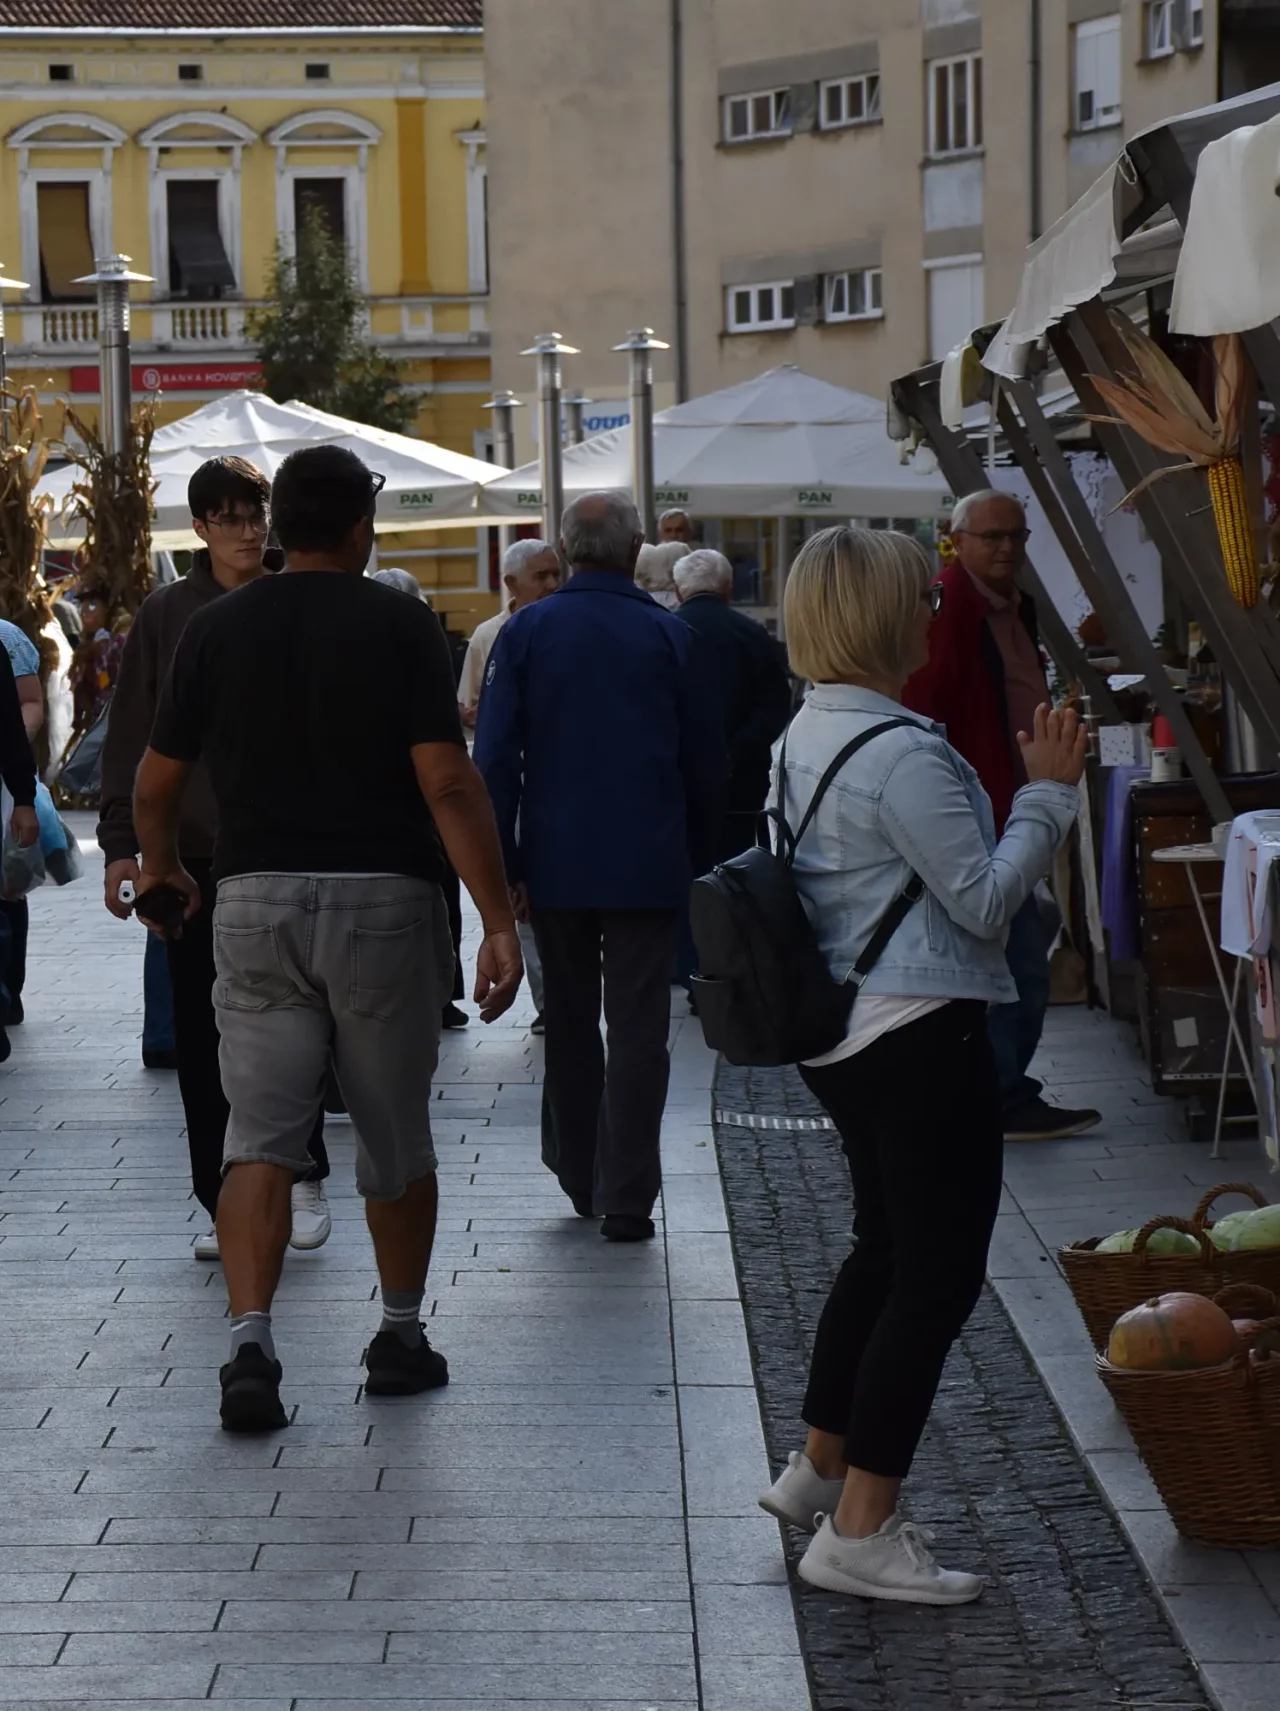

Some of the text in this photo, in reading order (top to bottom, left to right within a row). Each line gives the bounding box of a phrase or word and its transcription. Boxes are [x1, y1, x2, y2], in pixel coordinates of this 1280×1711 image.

[163, 374, 202, 383] BANKA
[400, 493, 433, 504] PAN
[655, 491, 689, 502] PAN
[798, 491, 832, 503] PAN
